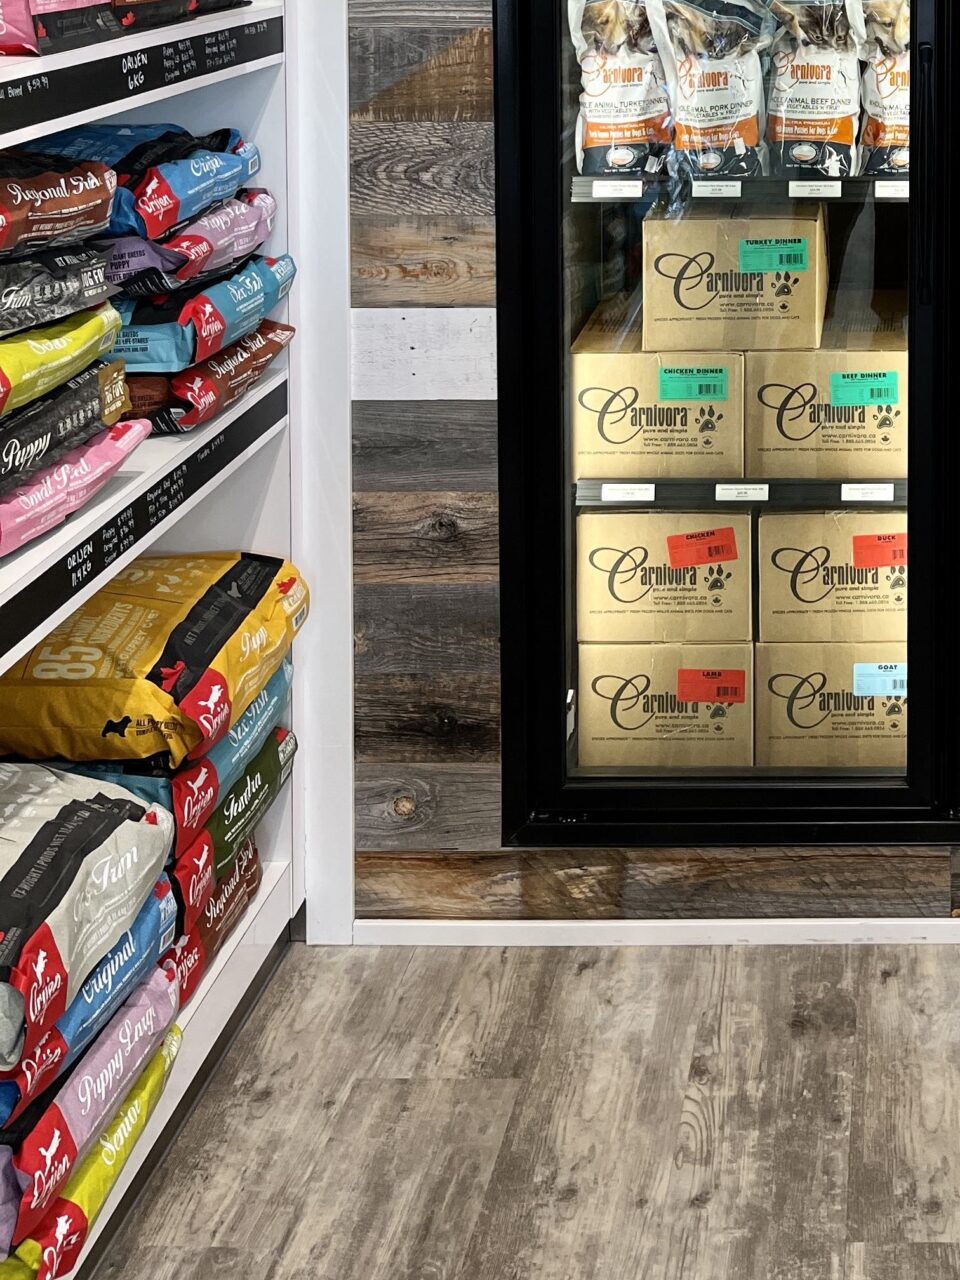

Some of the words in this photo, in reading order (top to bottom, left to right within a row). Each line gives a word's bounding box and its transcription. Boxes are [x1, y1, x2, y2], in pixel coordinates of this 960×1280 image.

[122, 53, 147, 73] ORIJEN
[128, 72, 145, 90] 6KG
[138, 194, 173, 220] Orijen
[110, 260, 130, 269] PUPPY
[654, 252, 764, 310] Carnivora
[2, 286, 32, 310] Trim
[578, 386, 688, 444] Carnivora
[757, 383, 865, 441] Carnivora
[2, 431, 51, 475] Puppy
[67, 541, 93, 570] ORIJEN
[686, 531, 715, 540] CHICKEN
[589, 546, 696, 603] Carnivora
[771, 546, 878, 603] Carnivora
[33, 645, 103, 680] 85
[592, 674, 698, 730] Carnivora
[768, 672, 874, 729] Carnivora
[184, 785, 213, 828] Orijen
[224, 772, 261, 825] Tundra
[163, 948, 199, 990] Orijen
[29, 972, 62, 1023] Orijen
[102, 1099, 141, 1166] Senior
[31, 1154, 70, 1209] Orijen
